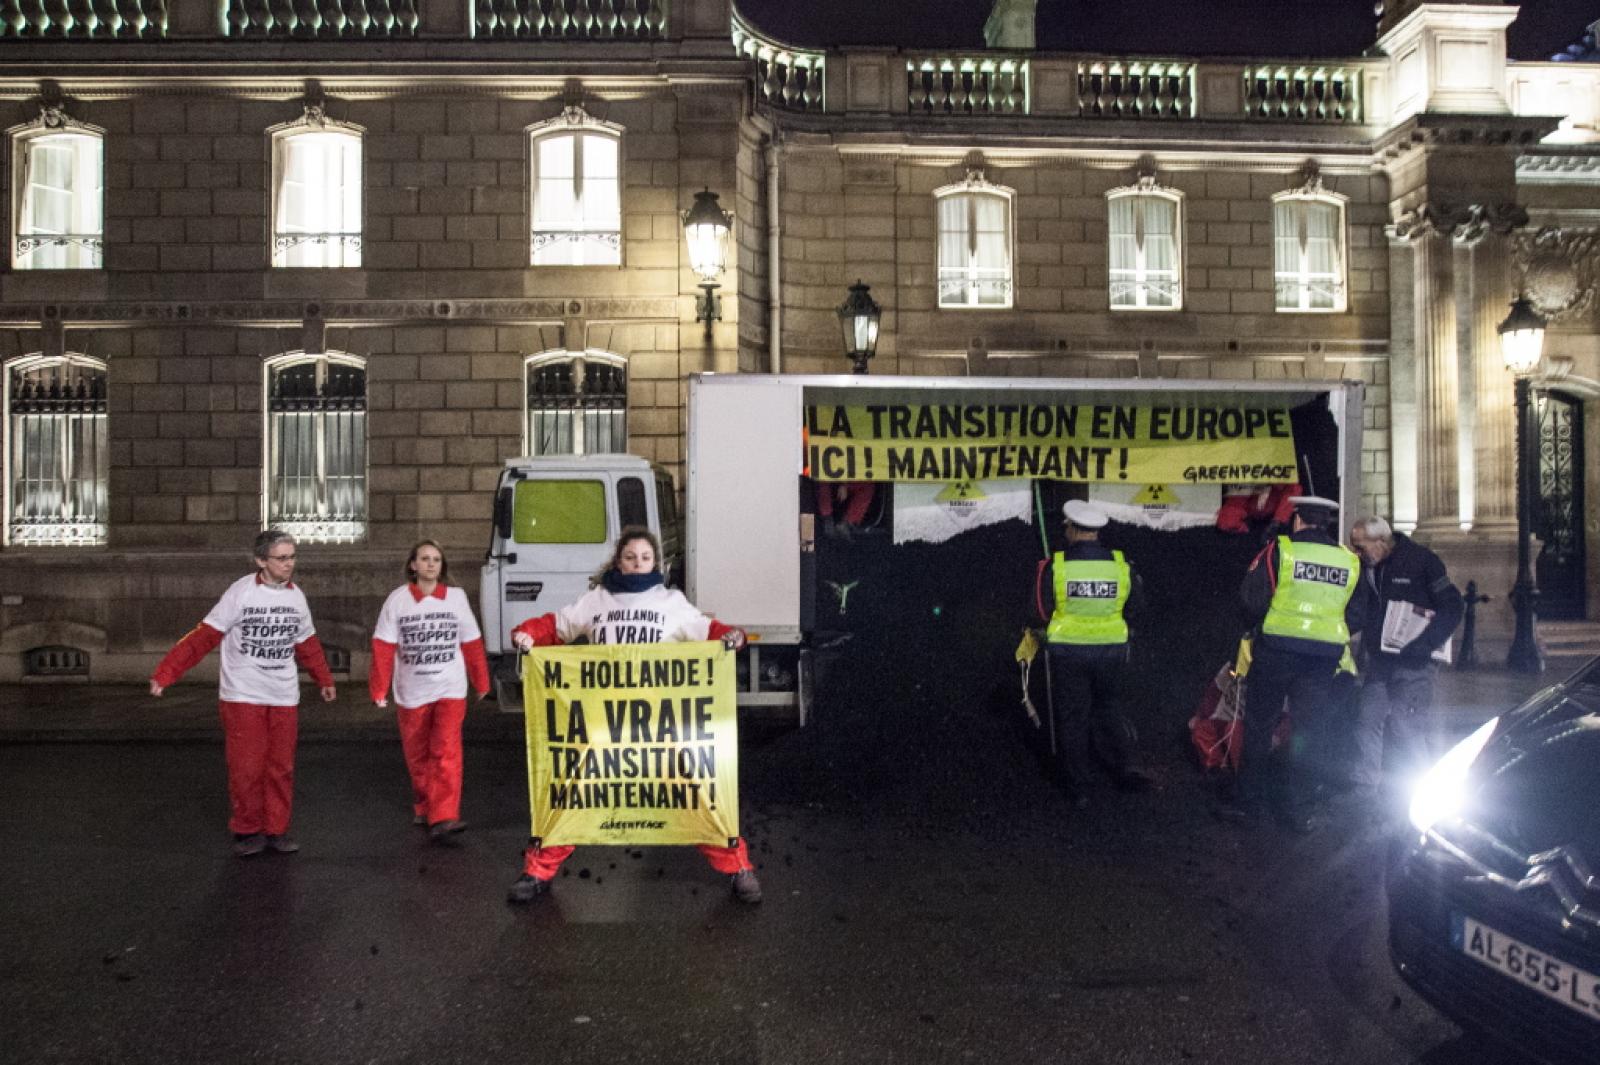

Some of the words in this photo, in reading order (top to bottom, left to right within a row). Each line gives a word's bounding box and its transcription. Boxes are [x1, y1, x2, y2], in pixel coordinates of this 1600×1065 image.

[808, 405, 853, 438] LA
[866, 405, 1078, 438] TRANSITION
[1092, 406, 1136, 439] EN
[1150, 407, 1290, 440] EUROPE
[1184, 465, 1296, 484] GREENPEACE
[1294, 562, 1348, 586] POLICE
[1067, 582, 1117, 597] POLICE
[544, 661, 570, 689] M.
[546, 699, 589, 744] LA
[604, 697, 715, 744] VRAIE
[548, 746, 716, 779] TRANSITION
